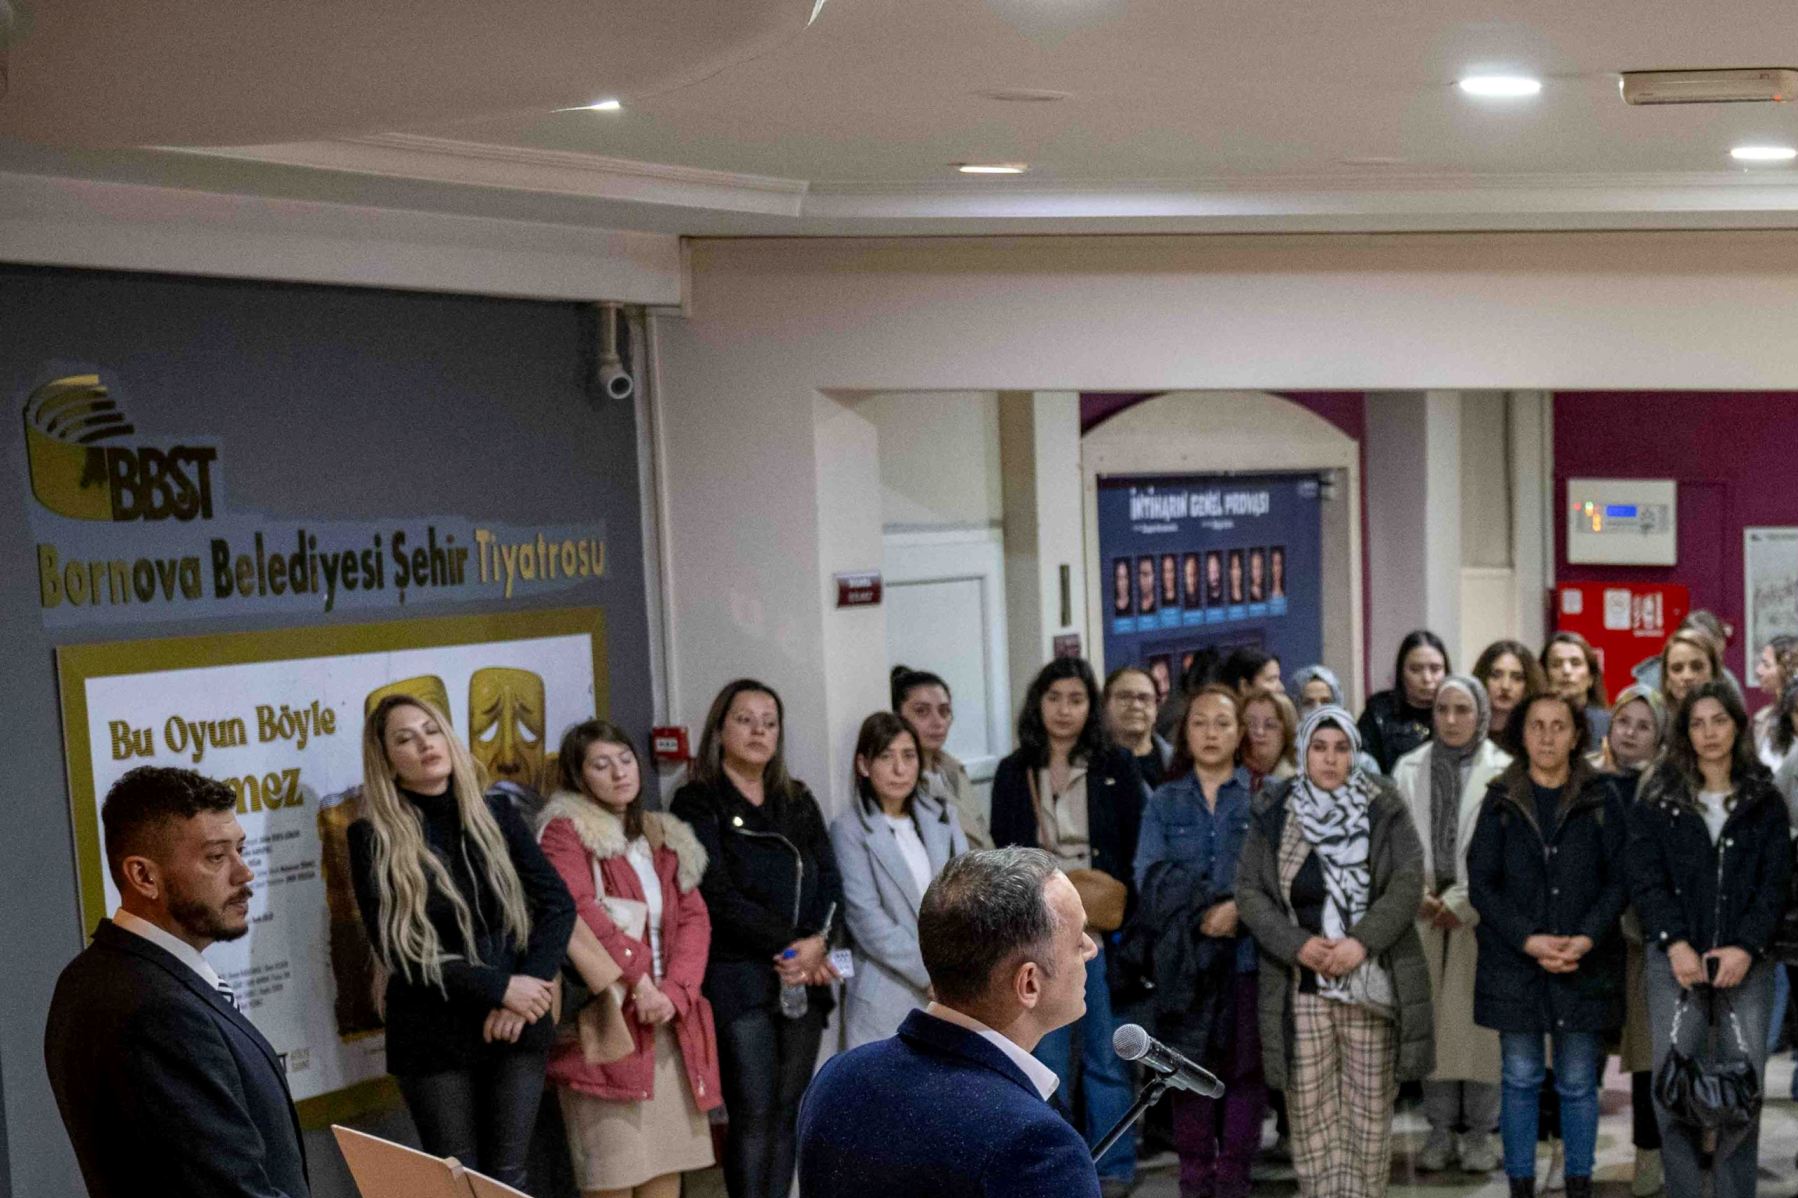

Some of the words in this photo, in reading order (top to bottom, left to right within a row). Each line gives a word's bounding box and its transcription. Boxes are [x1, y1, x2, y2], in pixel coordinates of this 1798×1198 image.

[108, 444, 218, 522] BBST
[36, 543, 203, 608] Bornova
[211, 529, 385, 612] Belediyesi
[392, 526, 469, 605] Şehir
[475, 528, 607, 599] Tiyatrosu
[108, 719, 155, 760] Bu
[163, 714, 248, 763] Oyun
[256, 700, 336, 751] Böyle
